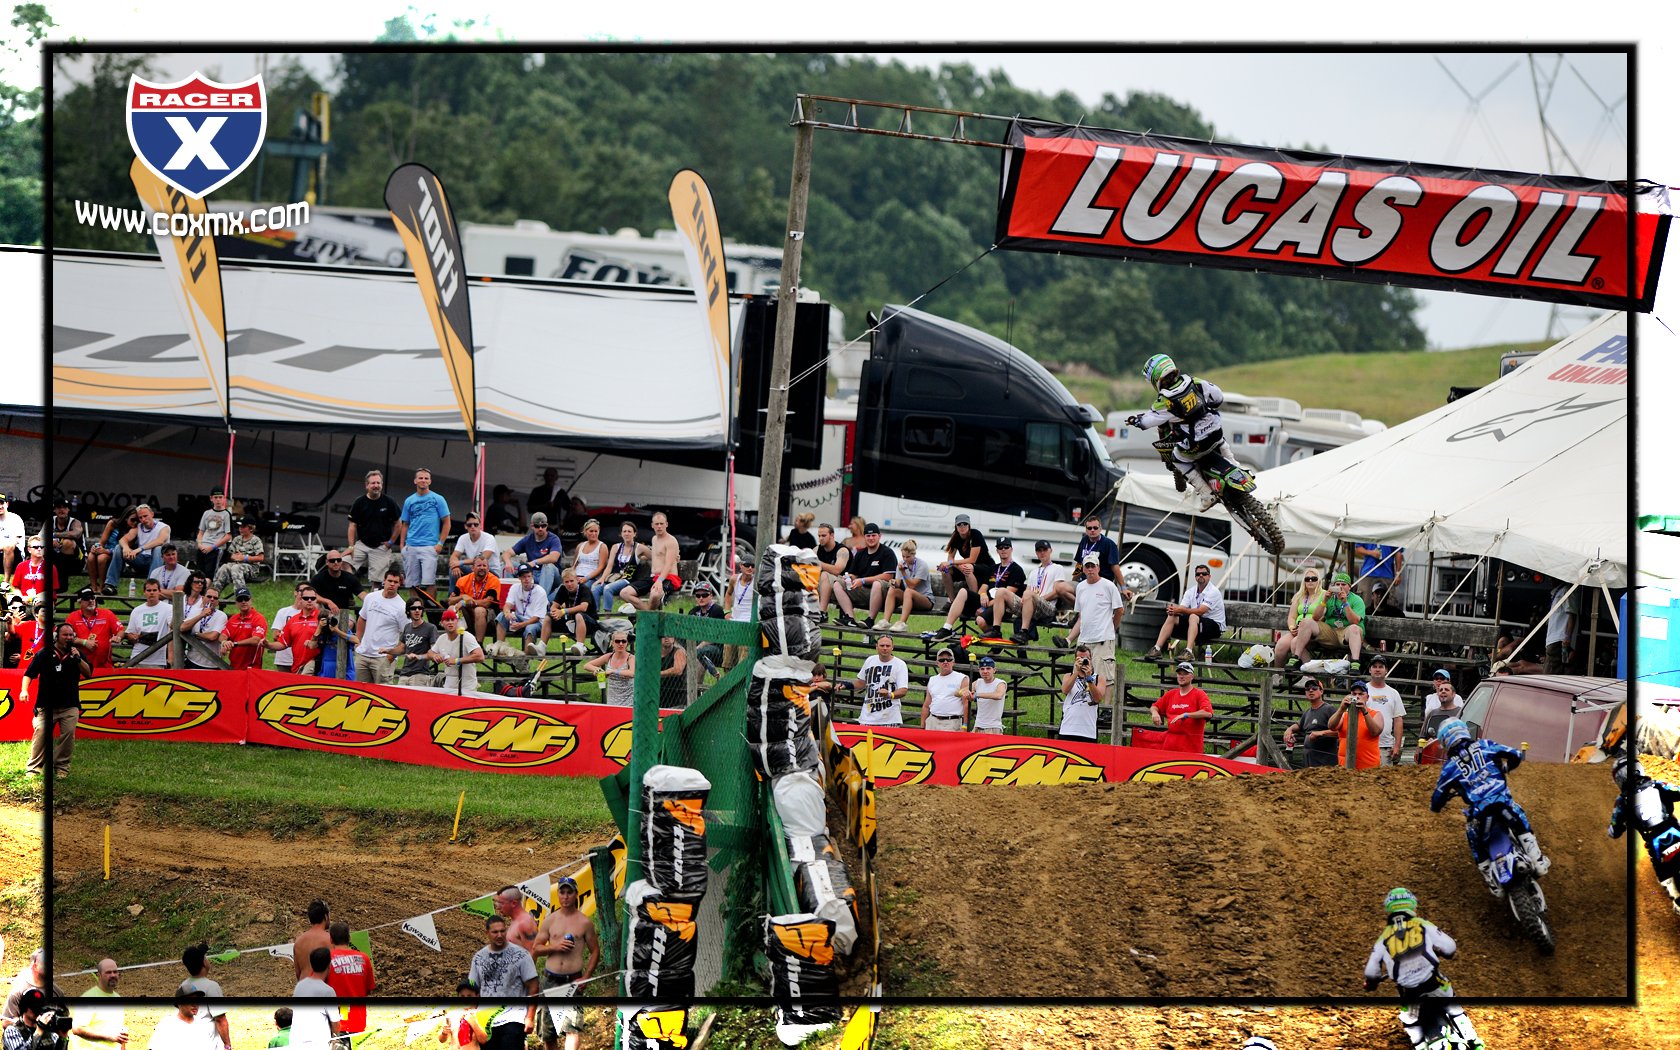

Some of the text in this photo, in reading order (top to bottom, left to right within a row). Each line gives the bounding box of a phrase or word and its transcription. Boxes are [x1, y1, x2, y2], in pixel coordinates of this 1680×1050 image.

[1049, 145, 1607, 284] LUCAS OIL
[1576, 335, 1628, 364] PA
[68, 490, 160, 509] TOYOTA
[79, 683, 218, 719] FMF
[258, 693, 409, 736] FMF
[870, 700, 893, 714] 2010
[431, 715, 577, 753] FMF
[852, 740, 934, 780] MF
[673, 824, 685, 890] thor
[402, 922, 438, 946] Kawasaki
[652, 926, 667, 998] thor
